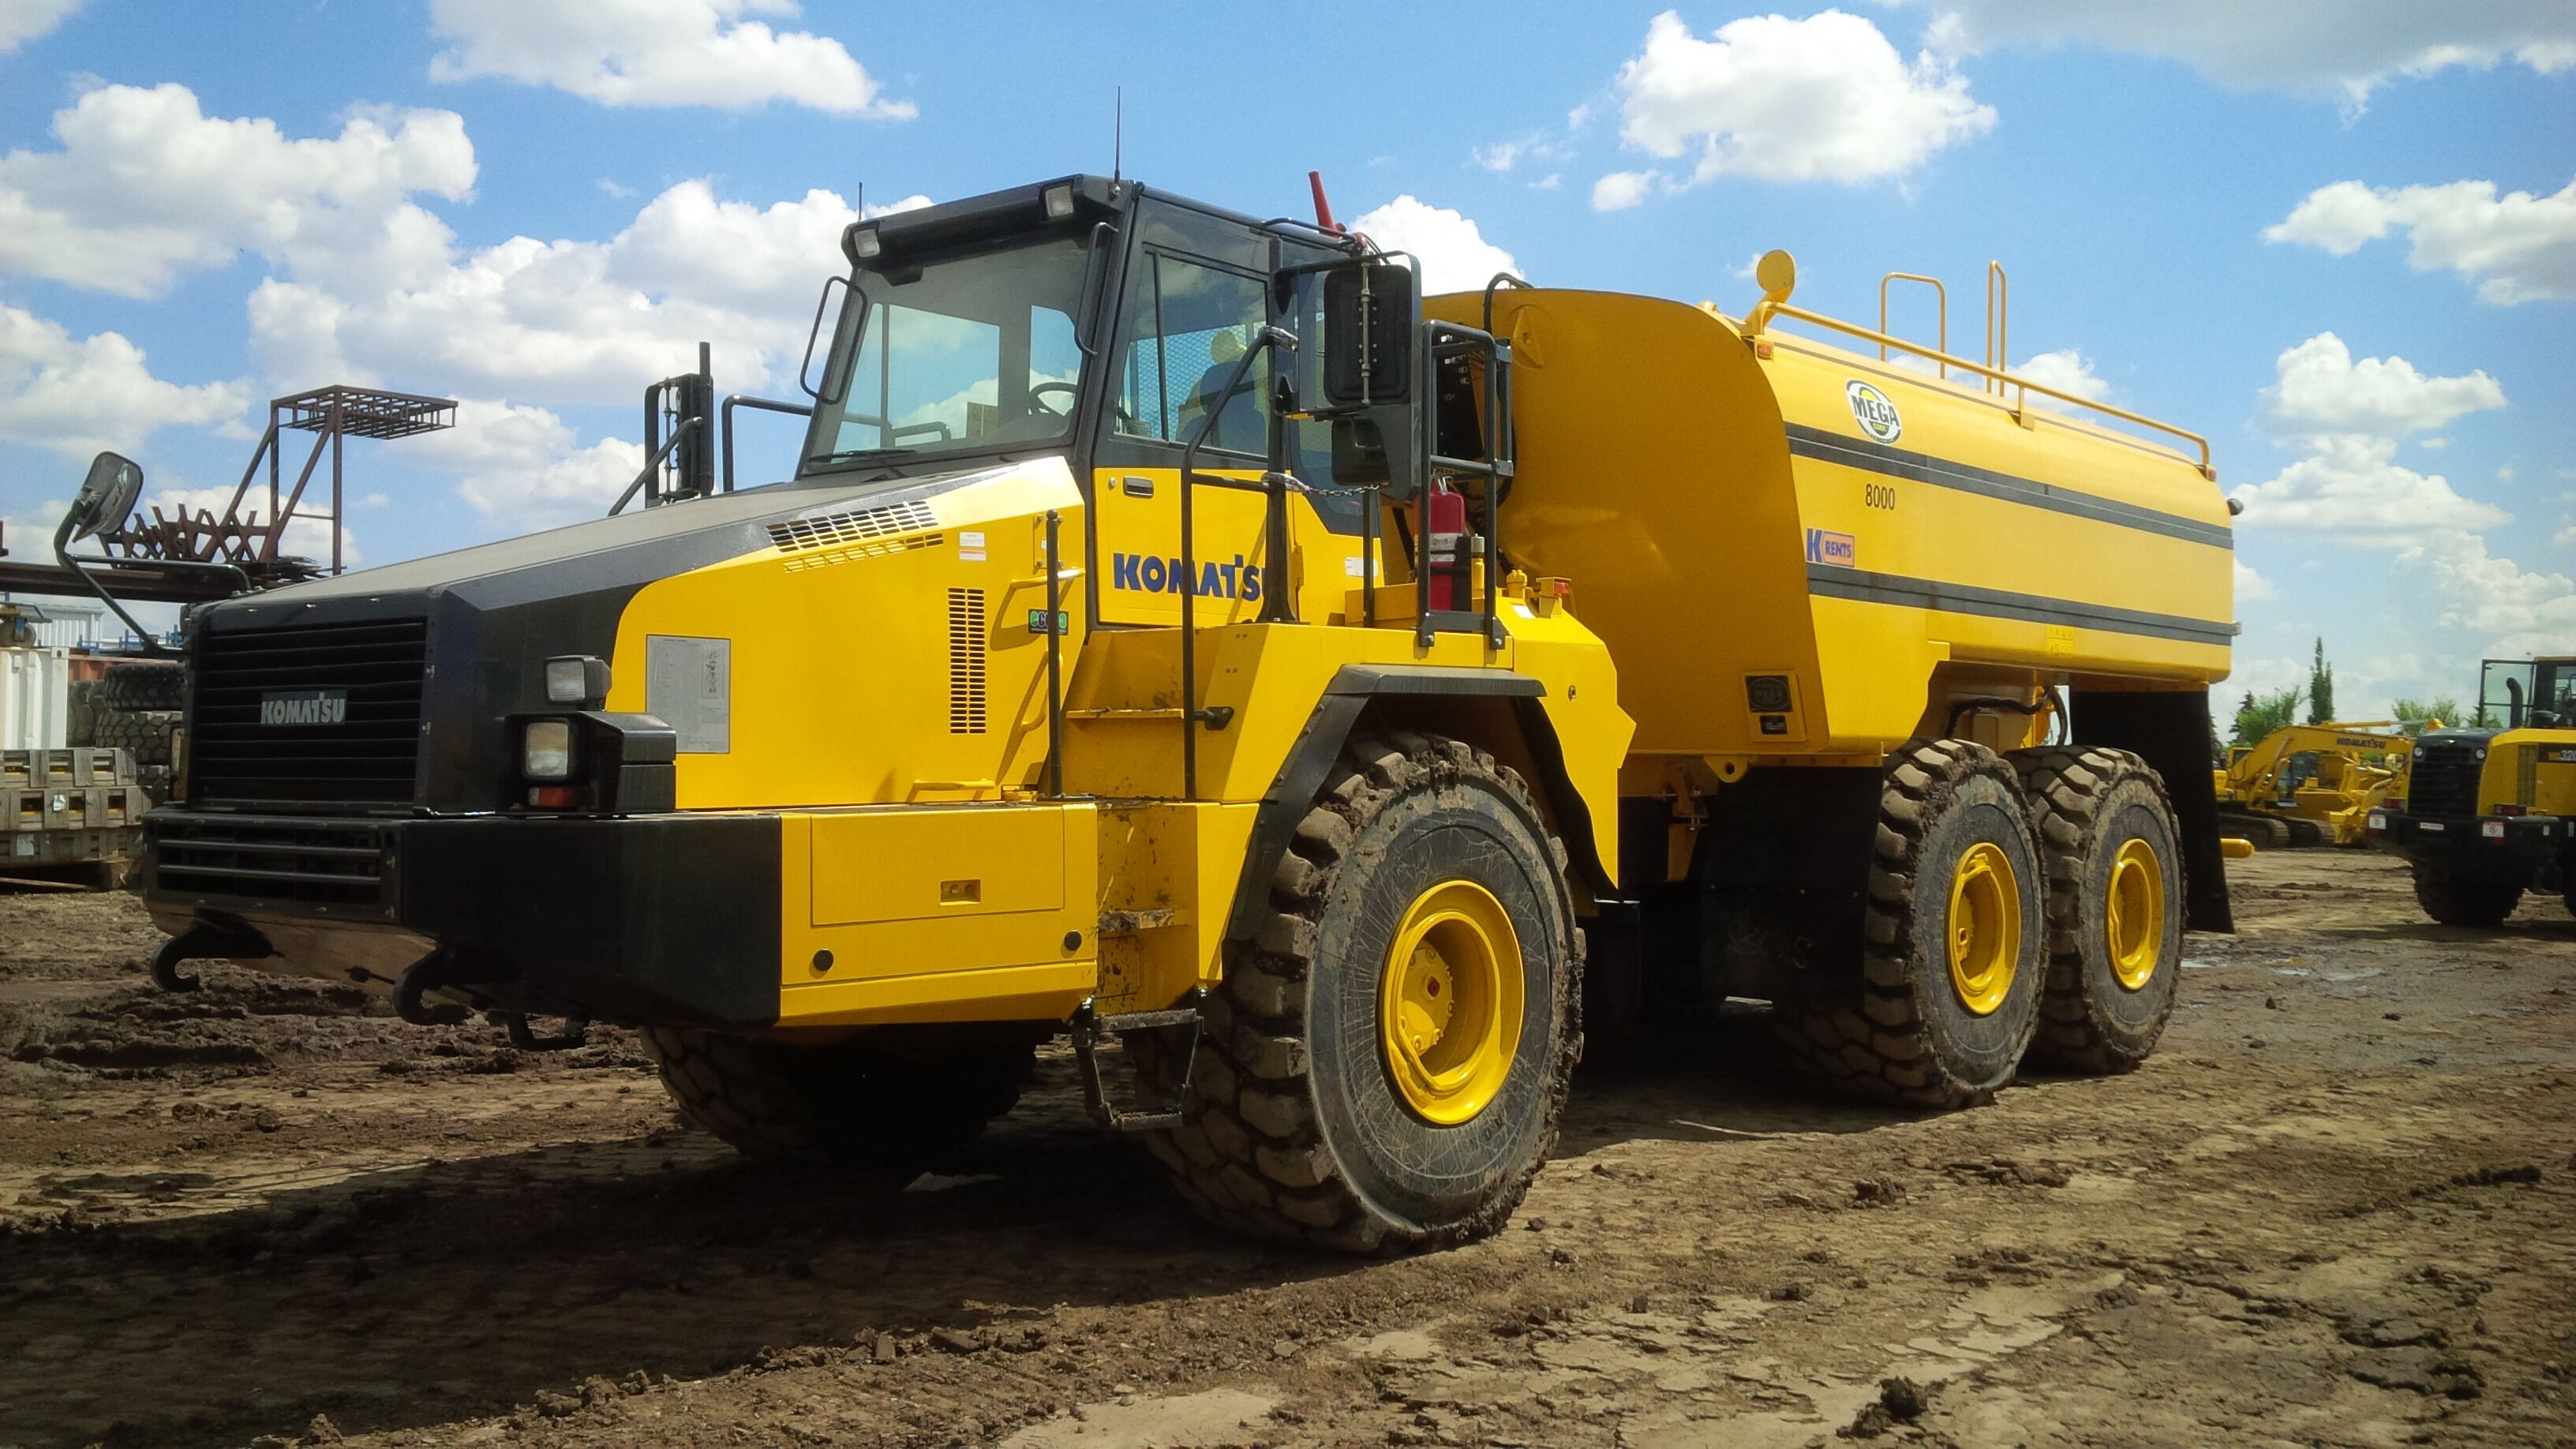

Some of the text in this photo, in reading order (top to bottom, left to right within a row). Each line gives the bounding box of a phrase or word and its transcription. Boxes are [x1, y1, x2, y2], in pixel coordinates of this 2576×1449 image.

[1851, 395, 1900, 427] MEGA
[1865, 482, 1896, 511] 8000
[1807, 528, 1852, 564] K RENTS
[1113, 552, 1266, 602] KOMATS
[260, 691, 346, 724] KOMATSU
[2337, 737, 2387, 750] KOMATSU
